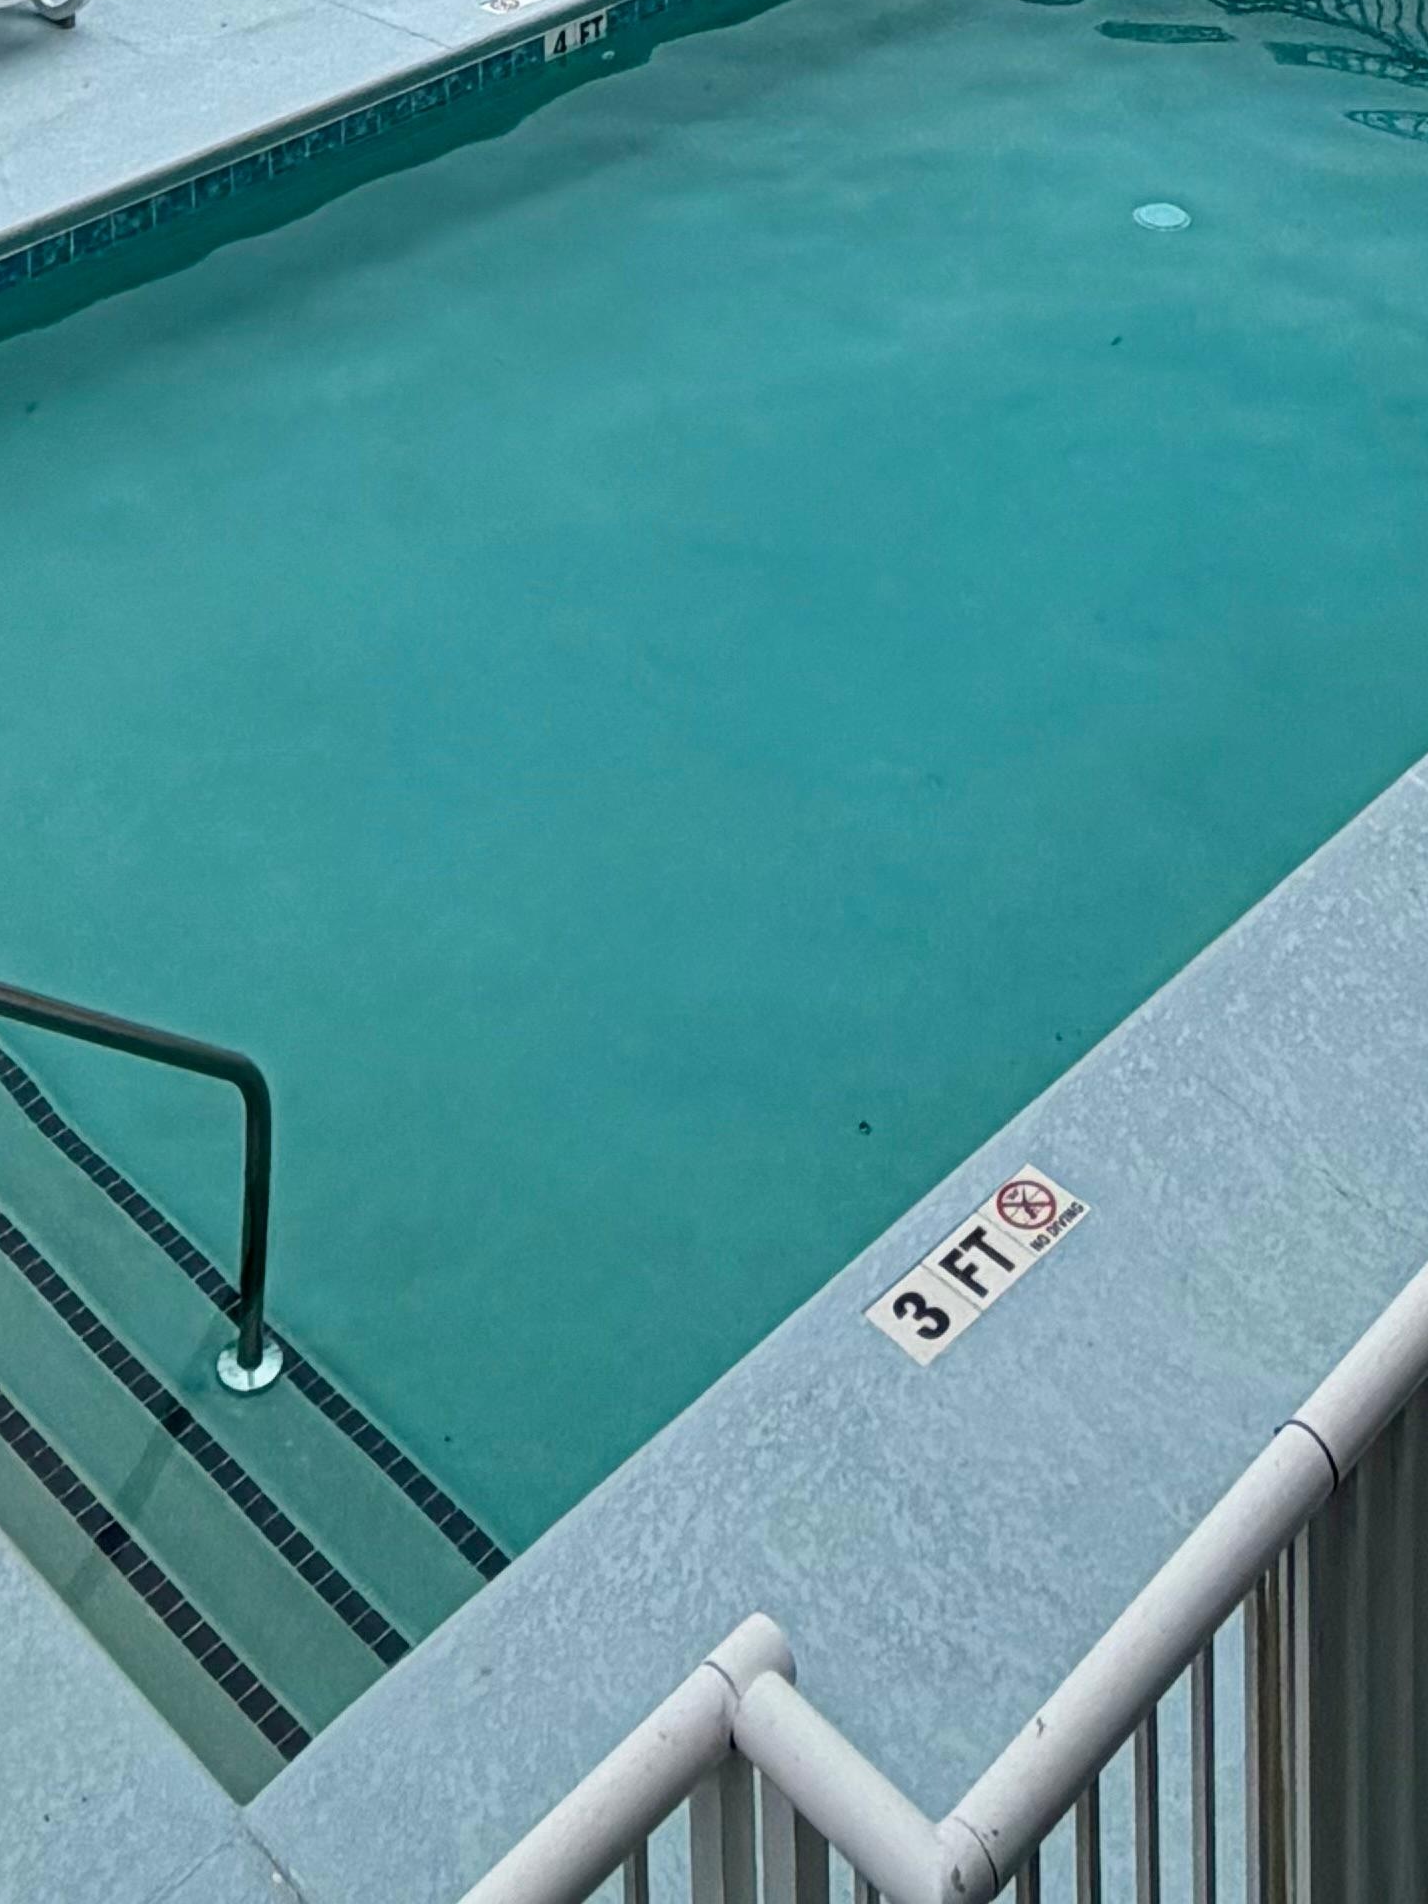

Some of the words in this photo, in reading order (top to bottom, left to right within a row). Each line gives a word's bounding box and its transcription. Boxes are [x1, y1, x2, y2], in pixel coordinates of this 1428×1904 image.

[579, 14, 604, 46] FT
[1029, 1233, 1052, 1252] NO
[1045, 1201, 1085, 1238] DIVING
[892, 1291, 951, 1341] 3
[938, 1225, 1016, 1299] FT
